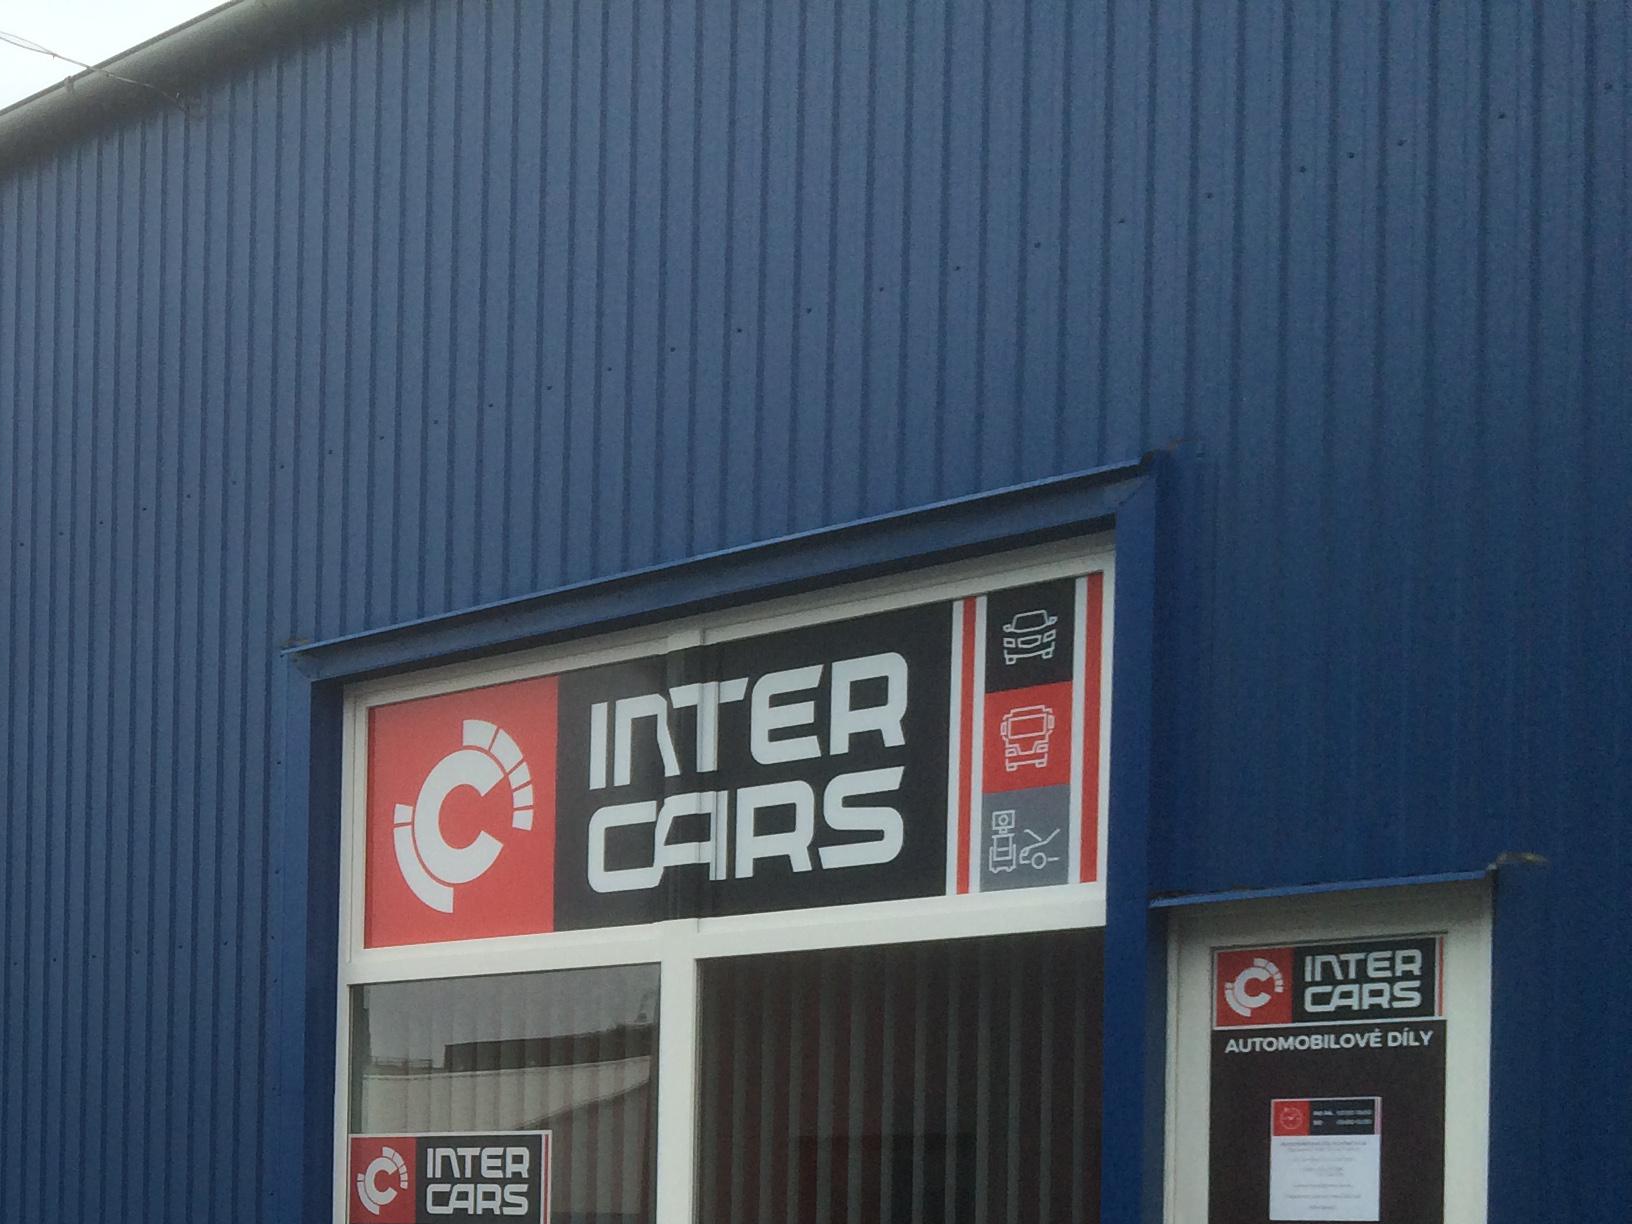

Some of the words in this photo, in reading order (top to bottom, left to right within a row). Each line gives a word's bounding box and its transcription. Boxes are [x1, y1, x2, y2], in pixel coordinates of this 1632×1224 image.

[589, 651, 908, 790] INTER
[587, 765, 906, 894] CARS
[1304, 949, 1422, 982] INTER
[1304, 980, 1421, 1013] CARS
[1225, 1028, 1382, 1053] AUTOMOBILOVÉ
[1387, 1027, 1434, 1047] DÍLY
[426, 1147, 530, 1179] INTER
[426, 1183, 529, 1216] CARS
